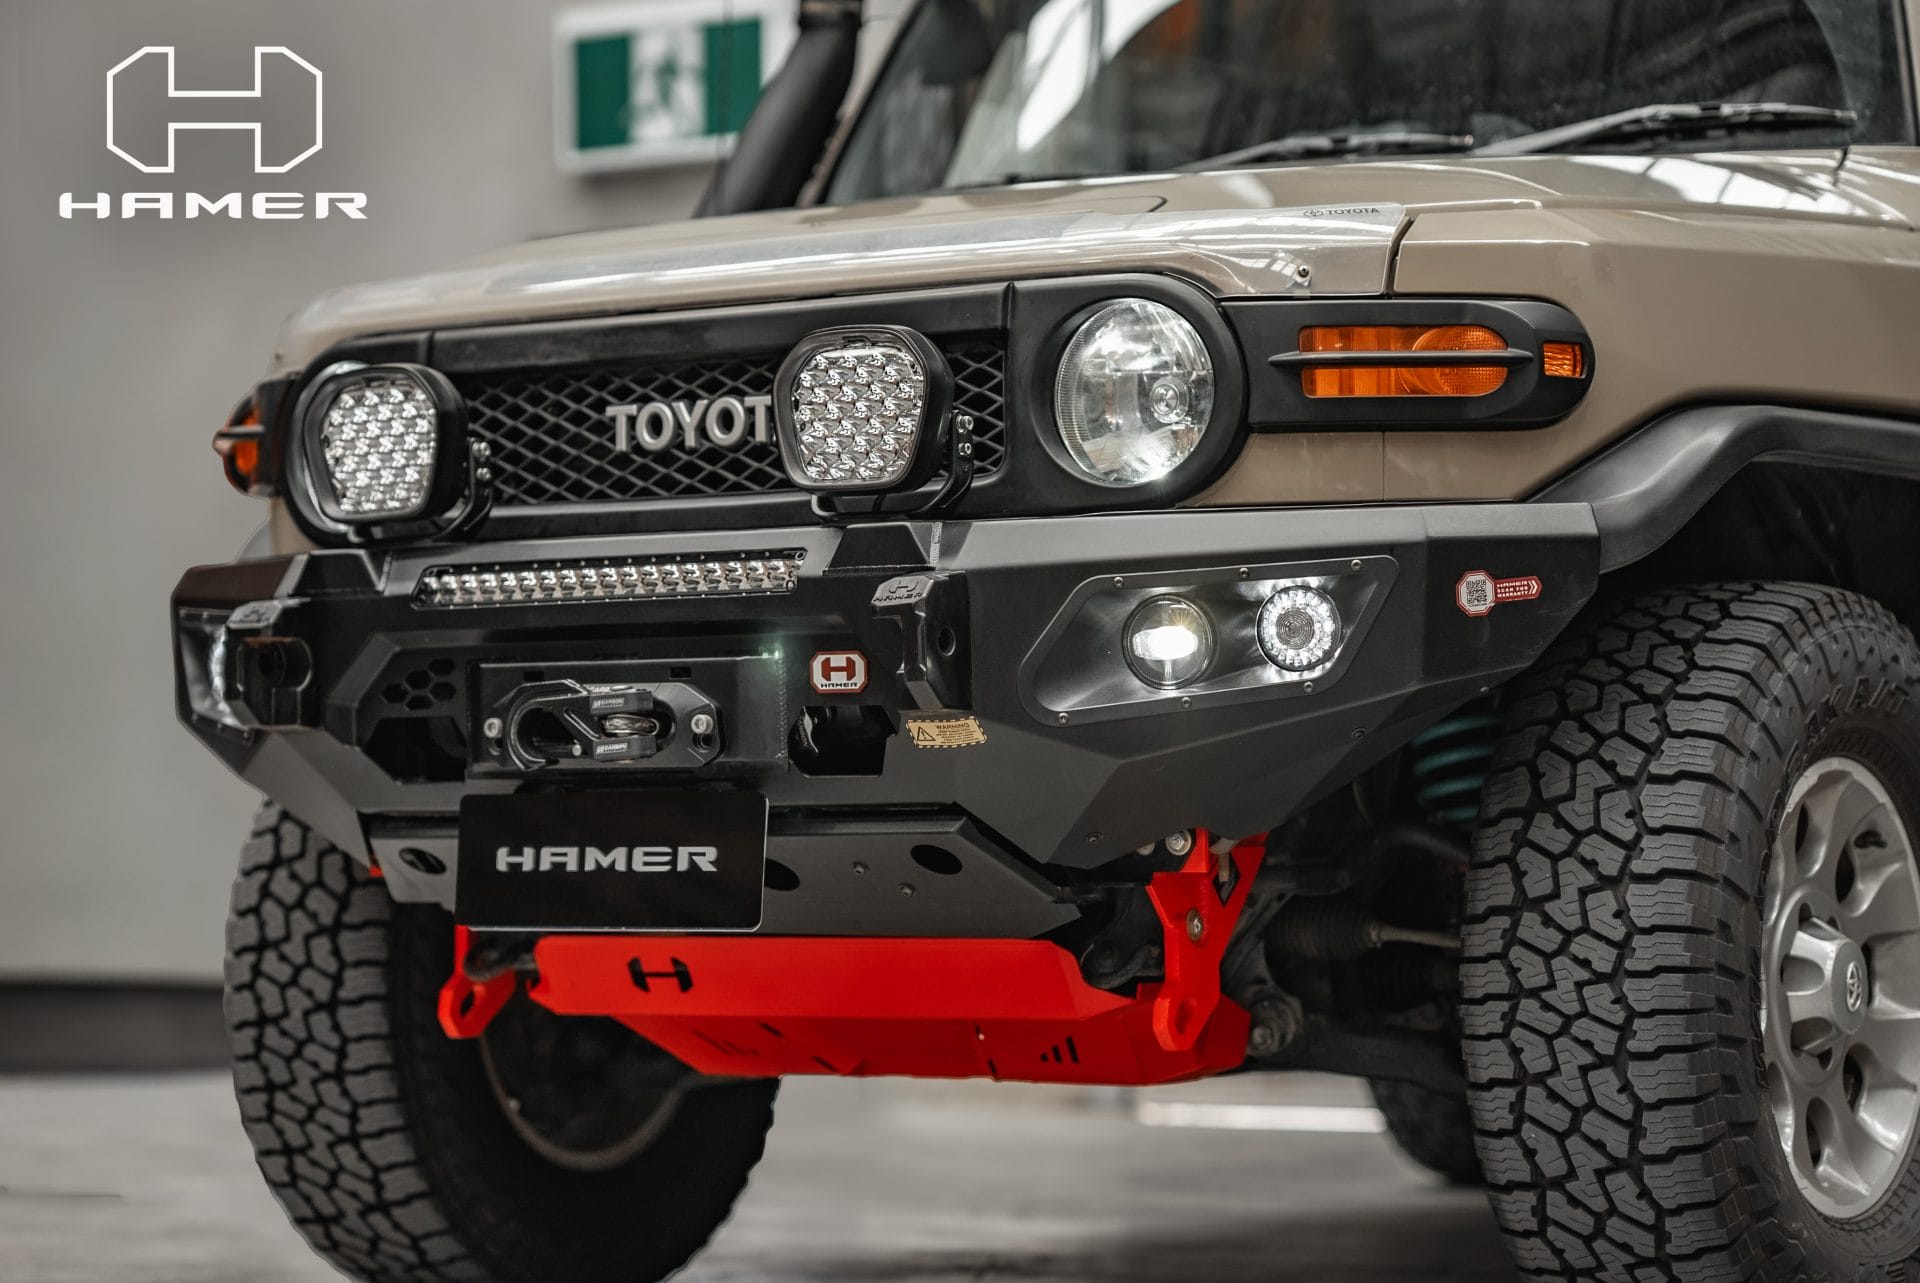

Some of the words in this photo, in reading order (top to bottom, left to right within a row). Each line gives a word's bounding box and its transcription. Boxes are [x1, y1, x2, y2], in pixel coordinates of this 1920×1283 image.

[1327, 207, 1380, 216] TOYOTA
[605, 395, 772, 451] TOYOT
[1496, 580, 1528, 588] HAMER
[934, 722, 970, 730] WARNING
[496, 846, 718, 873] HAMER
